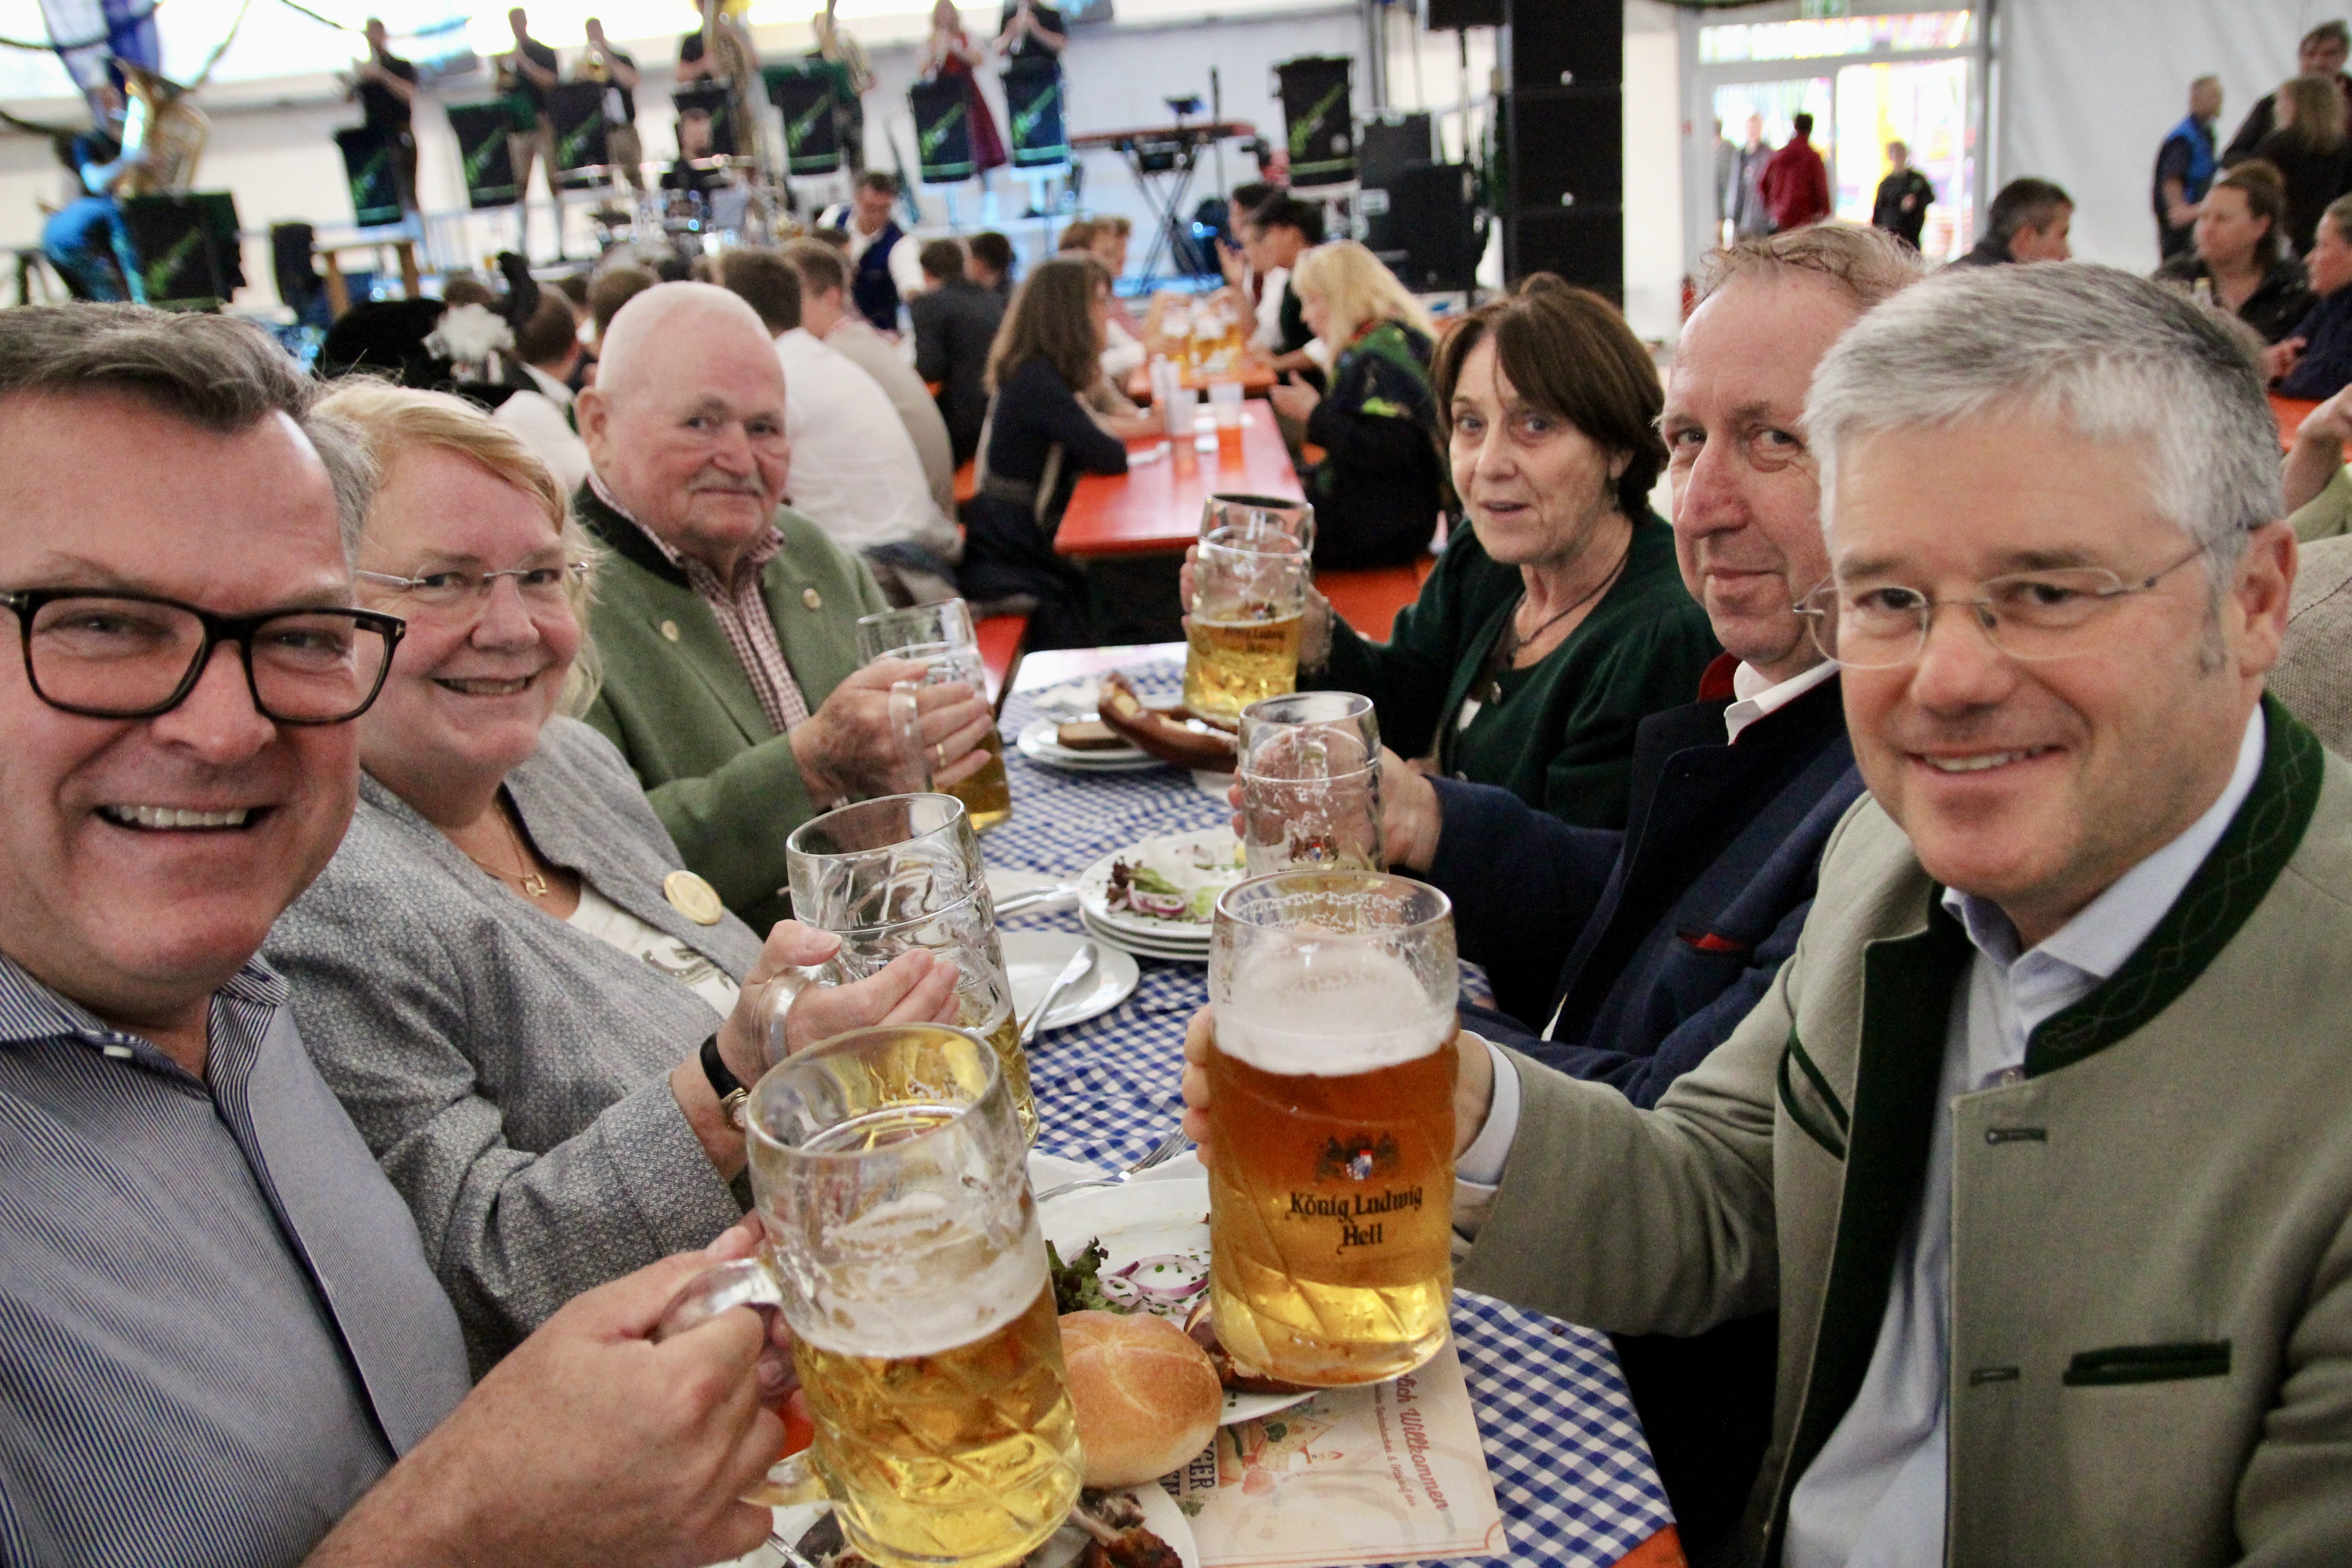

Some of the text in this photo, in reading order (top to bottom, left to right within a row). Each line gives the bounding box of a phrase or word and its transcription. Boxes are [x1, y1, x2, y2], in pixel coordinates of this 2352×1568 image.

[1284, 1186, 1423, 1223] König Ludwig
[1337, 1223, 1383, 1255] Hell
[1396, 1373, 1449, 1511] lich Willkommen
